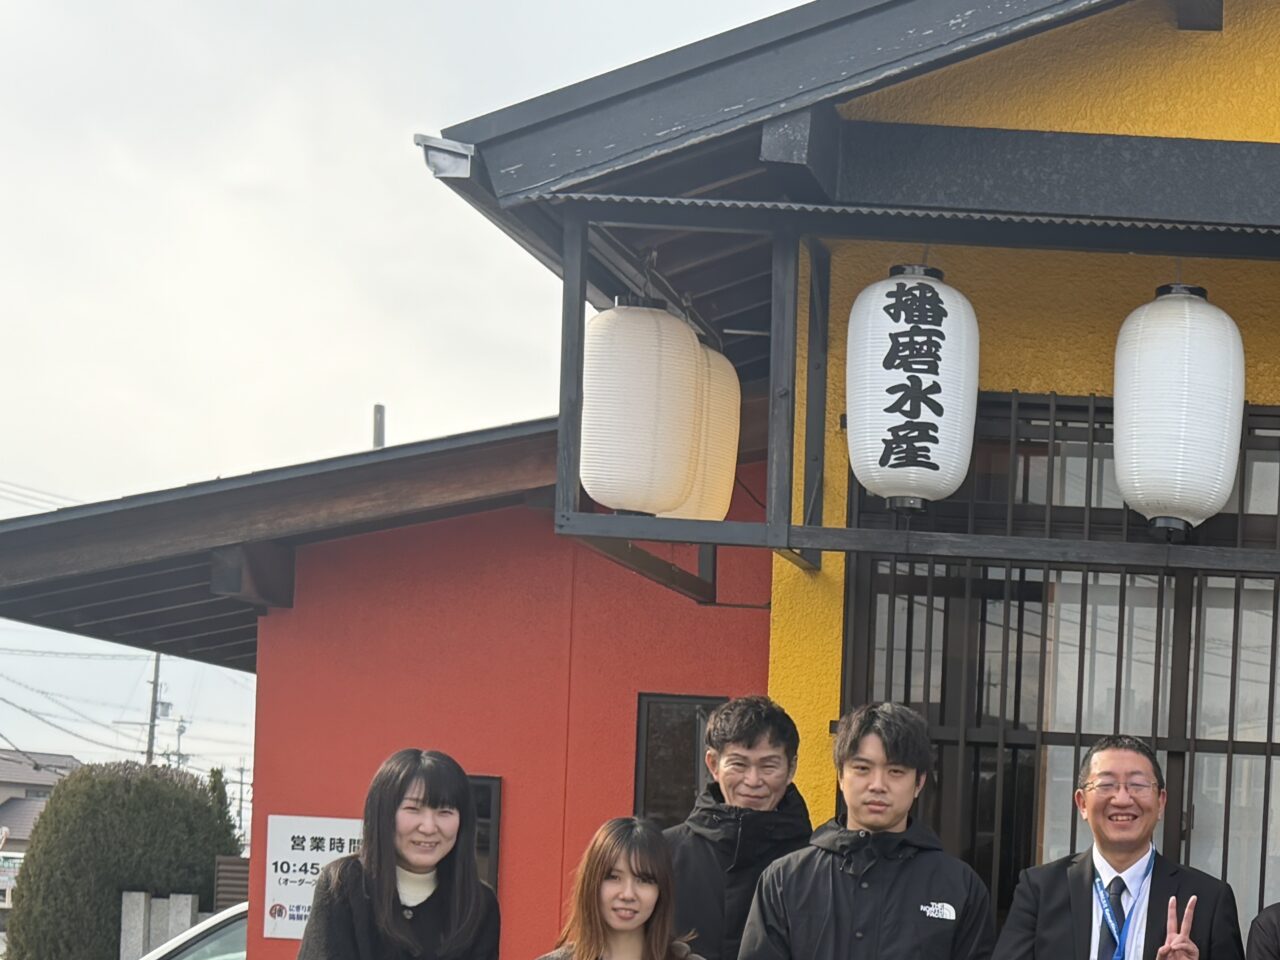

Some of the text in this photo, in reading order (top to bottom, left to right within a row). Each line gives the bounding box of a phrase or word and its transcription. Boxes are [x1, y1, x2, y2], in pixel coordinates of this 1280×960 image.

[878, 282, 949, 471] 播磨水産
[272, 861, 324, 875] 10:45
